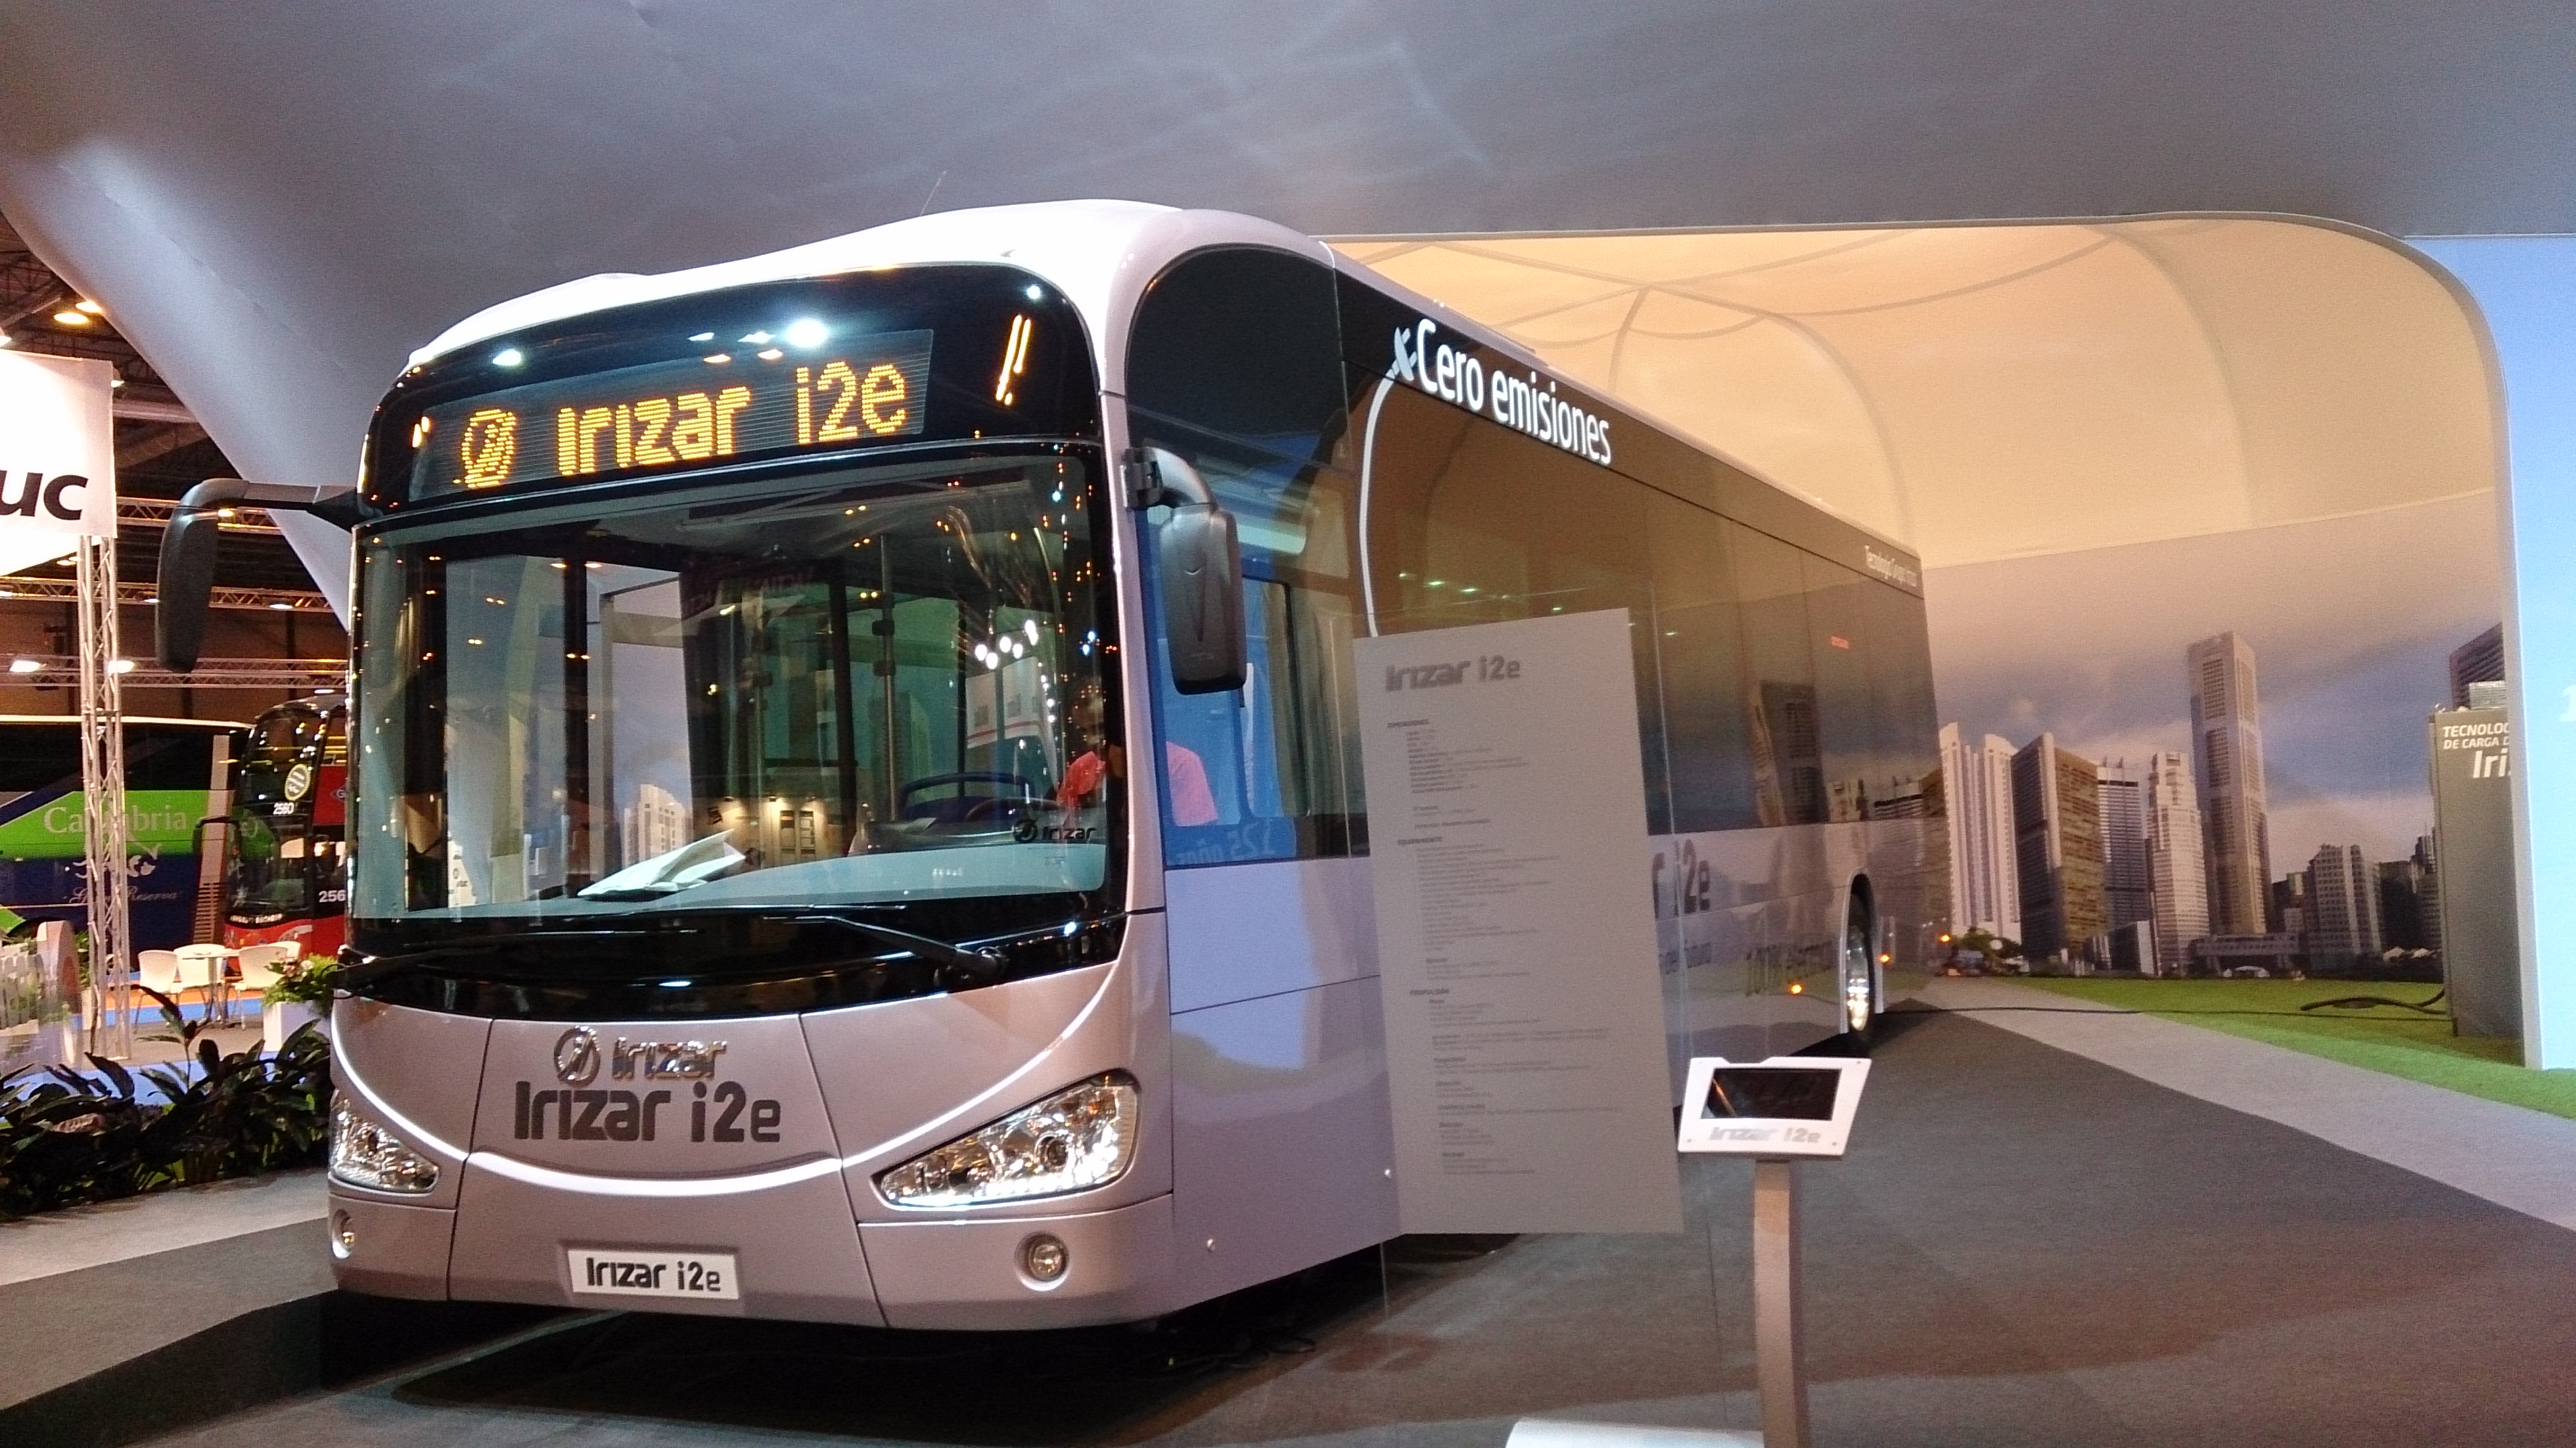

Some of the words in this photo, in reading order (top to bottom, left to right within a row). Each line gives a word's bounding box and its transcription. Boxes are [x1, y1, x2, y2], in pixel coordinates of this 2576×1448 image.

[1416, 318, 1484, 411] Cero
[1491, 371, 1612, 465] emisiones
[557, 385, 753, 476] Irizar
[794, 360, 908, 445] i2e
[1385, 660, 1471, 692] Irizar
[1479, 654, 1521, 683] i2e
[2443, 739, 2460, 750] DE
[2462, 736, 2499, 749] CARGA
[2473, 748, 2511, 779] Iri
[1042, 826, 1097, 840] Irizar
[612, 1036, 727, 1079] Irizar
[514, 1081, 672, 1142] Irizar
[691, 1081, 781, 1143] i2e
[1709, 1126, 1778, 1142] Irizar
[586, 1257, 666, 1289] Irizar
[677, 1261, 721, 1292] i2e
